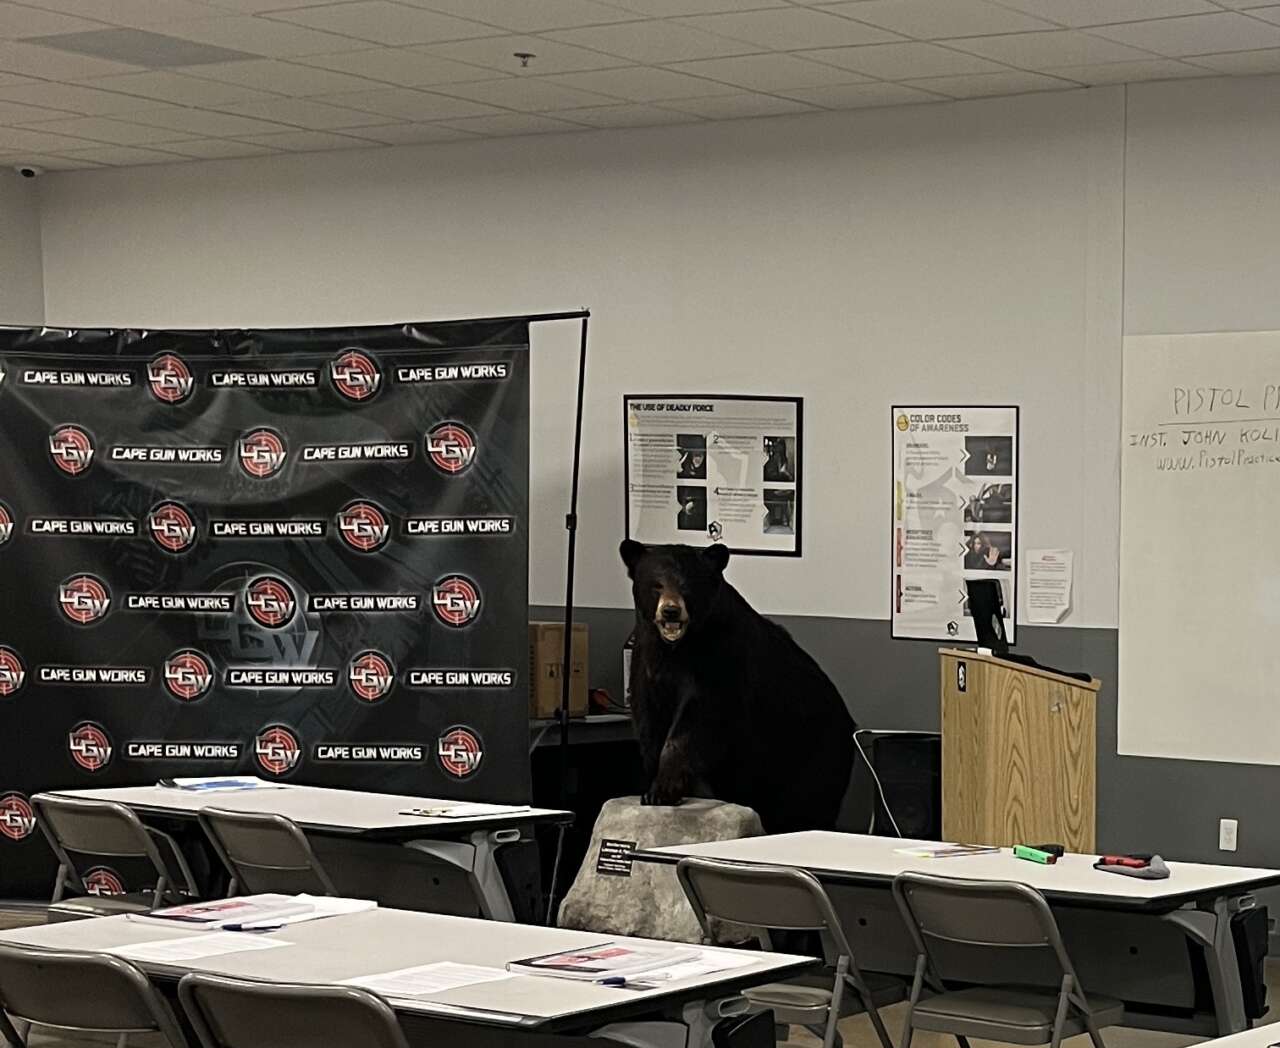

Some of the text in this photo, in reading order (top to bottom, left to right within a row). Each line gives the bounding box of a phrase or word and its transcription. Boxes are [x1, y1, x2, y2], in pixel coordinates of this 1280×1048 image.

[23, 370, 132, 386] CAPE GUN WORKS
[211, 372, 315, 386] CAPE GUN WORKS
[398, 364, 506, 381] CAPE GUN WORKS
[630, 402, 714, 413] THE USE OF DEADLY FORCE
[1173, 387, 1250, 415] PISTOL
[910, 414, 962, 423] COLOR CODES
[909, 423, 969, 432] OF AWARENESS
[1129, 432, 1168, 447] INST.
[1182, 428, 1226, 446] JOHN
[111, 447, 222, 462] CAPE GUN WORKS
[303, 444, 409, 460] CAPE GUN WORKS
[31, 519, 135, 534] CAPE GUN WORKS
[213, 522, 322, 535] CAPE GUN WORKS
[407, 519, 510, 533] CAPE GUN WORKS
[128, 596, 232, 609] CAPE GUN WORKS
[313, 596, 417, 609] CAPE GUN WORKS
[40, 668, 146, 683] CAPE GUN WORKS
[231, 671, 334, 684] CAPE GUN WORKS
[410, 672, 512, 685] CAPE GUN WORKS
[128, 744, 238, 758] CAPE GUN WORKS
[317, 746, 422, 760] CAPE GUN WORKS
